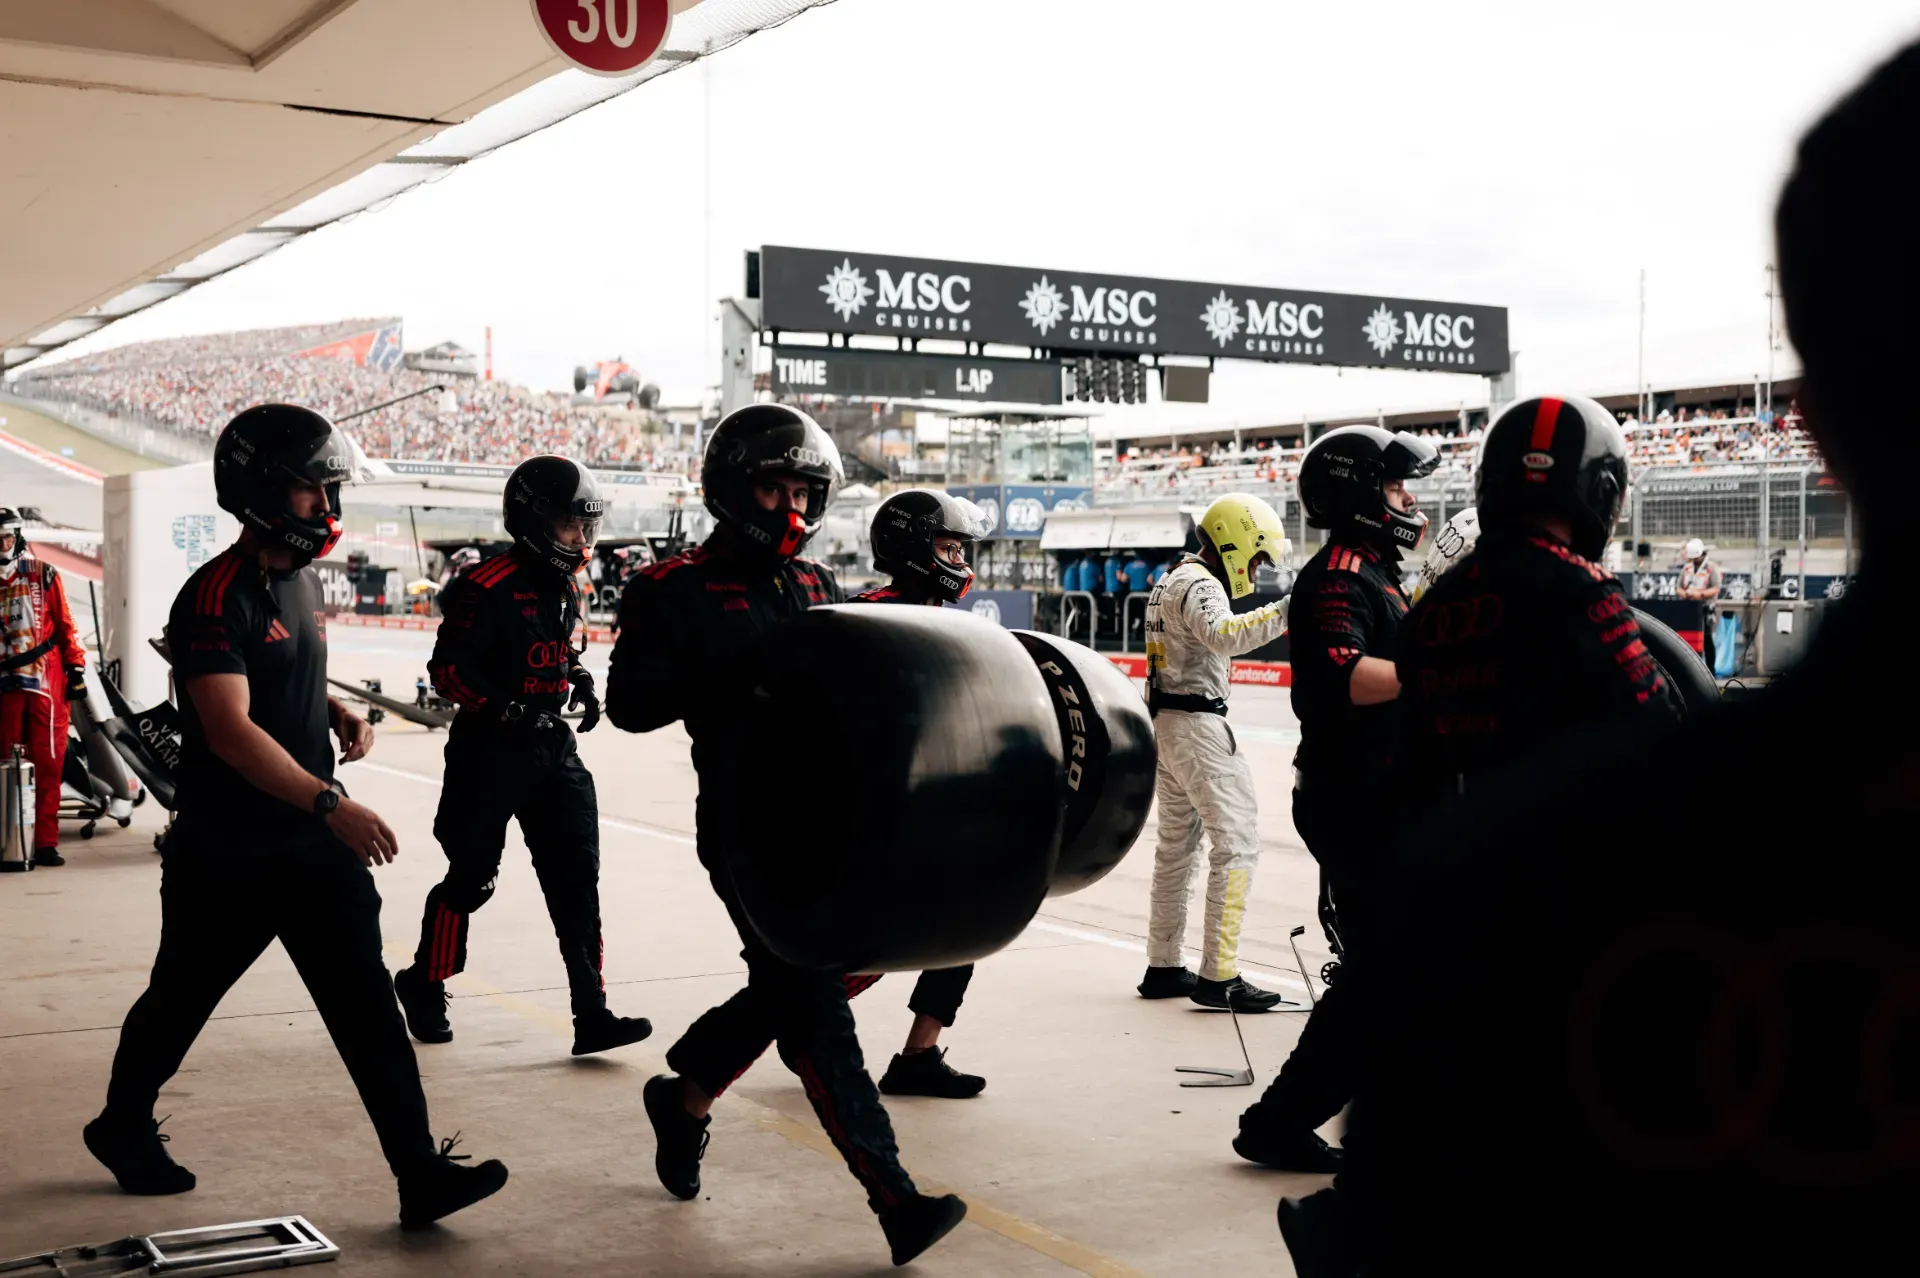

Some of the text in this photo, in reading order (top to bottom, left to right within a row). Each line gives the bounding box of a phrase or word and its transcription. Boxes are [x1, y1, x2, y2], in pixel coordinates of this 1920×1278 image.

[566, 0, 638, 48] 30
[875, 268, 971, 314] MSC
[1070, 284, 1157, 328] MSC
[1245, 298, 1324, 339] MSC
[875, 312, 971, 332] CRUISES
[1069, 326, 1157, 345] CRUISES
[1403, 310, 1475, 349] MSC
[1245, 338, 1324, 355] CRUISES
[1403, 348, 1475, 365] CRUISES
[776, 357, 827, 386] TIME
[955, 366, 994, 394] LAP
[1332, 454, 1354, 465] NEXO
[1360, 516, 1383, 528] Castrol
[911, 562, 930, 575] Castrol
[1231, 665, 1282, 684] Santander
[1039, 660, 1086, 792] P ZERO
[139, 718, 180, 770] QATAR
